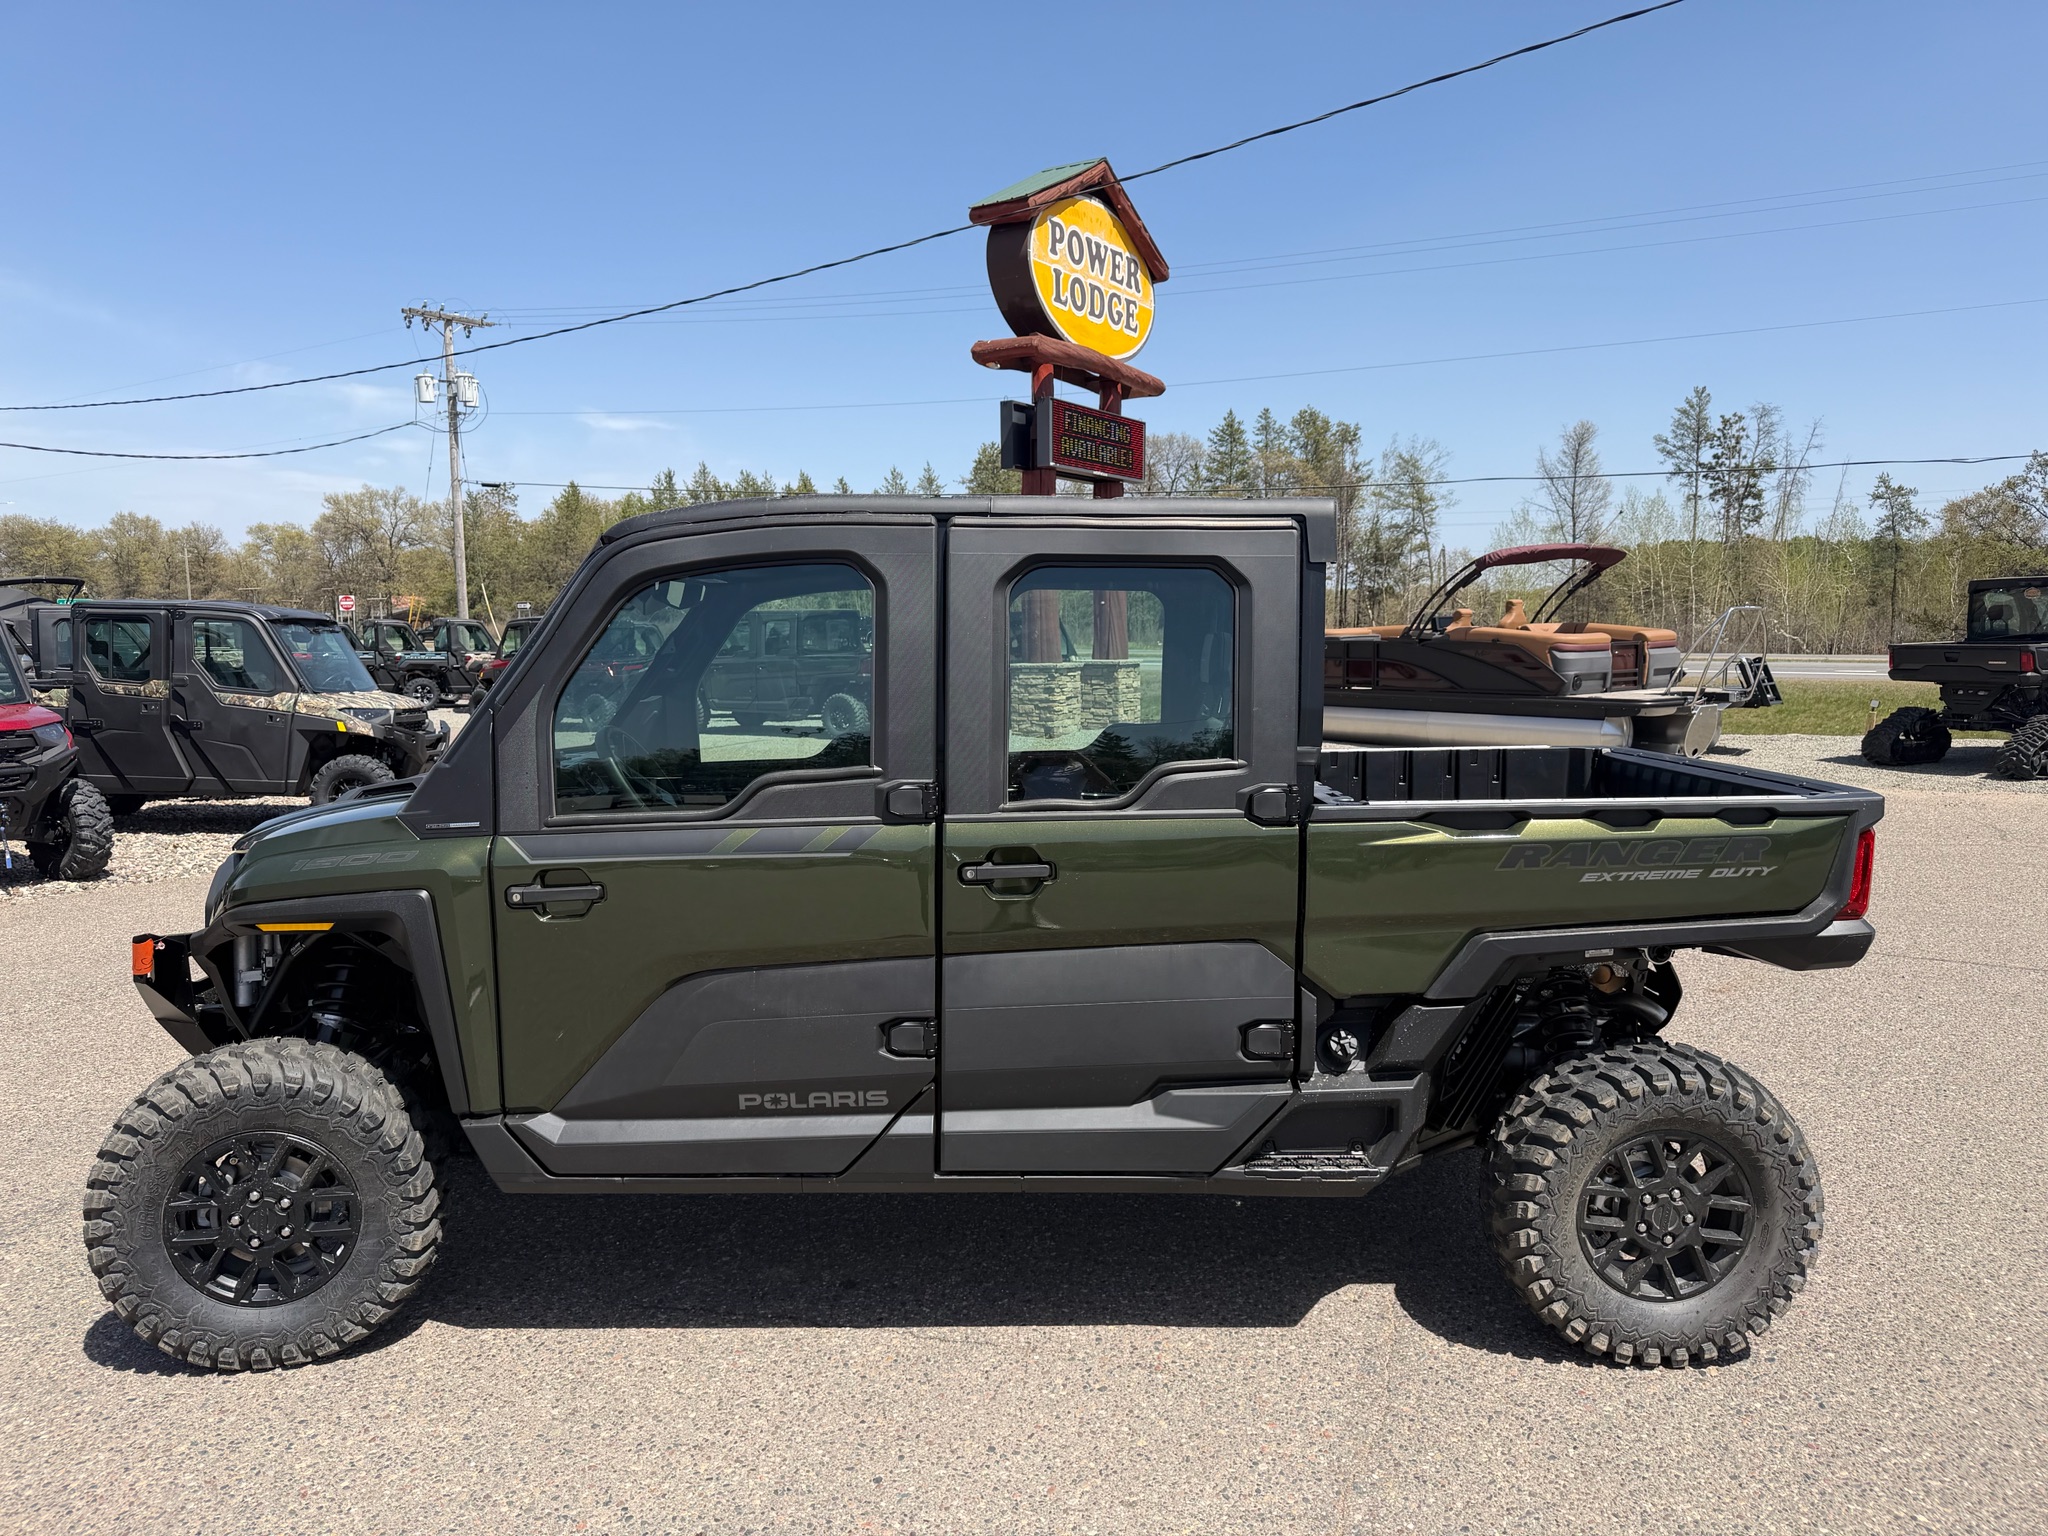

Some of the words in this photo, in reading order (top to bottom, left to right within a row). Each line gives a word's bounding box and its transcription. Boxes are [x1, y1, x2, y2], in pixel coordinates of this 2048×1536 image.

[1048, 217, 1141, 294] POWER
[1052, 267, 1138, 334] LODGE
[1064, 410, 1131, 444] FINANCING
[1061, 436, 1133, 468] AVAILABLE!
[1495, 836, 1772, 871] RANGER
[1579, 868, 1703, 883] EXTREME
[1708, 865, 1778, 878] DUTY
[738, 1090, 889, 1110] POLARIS
